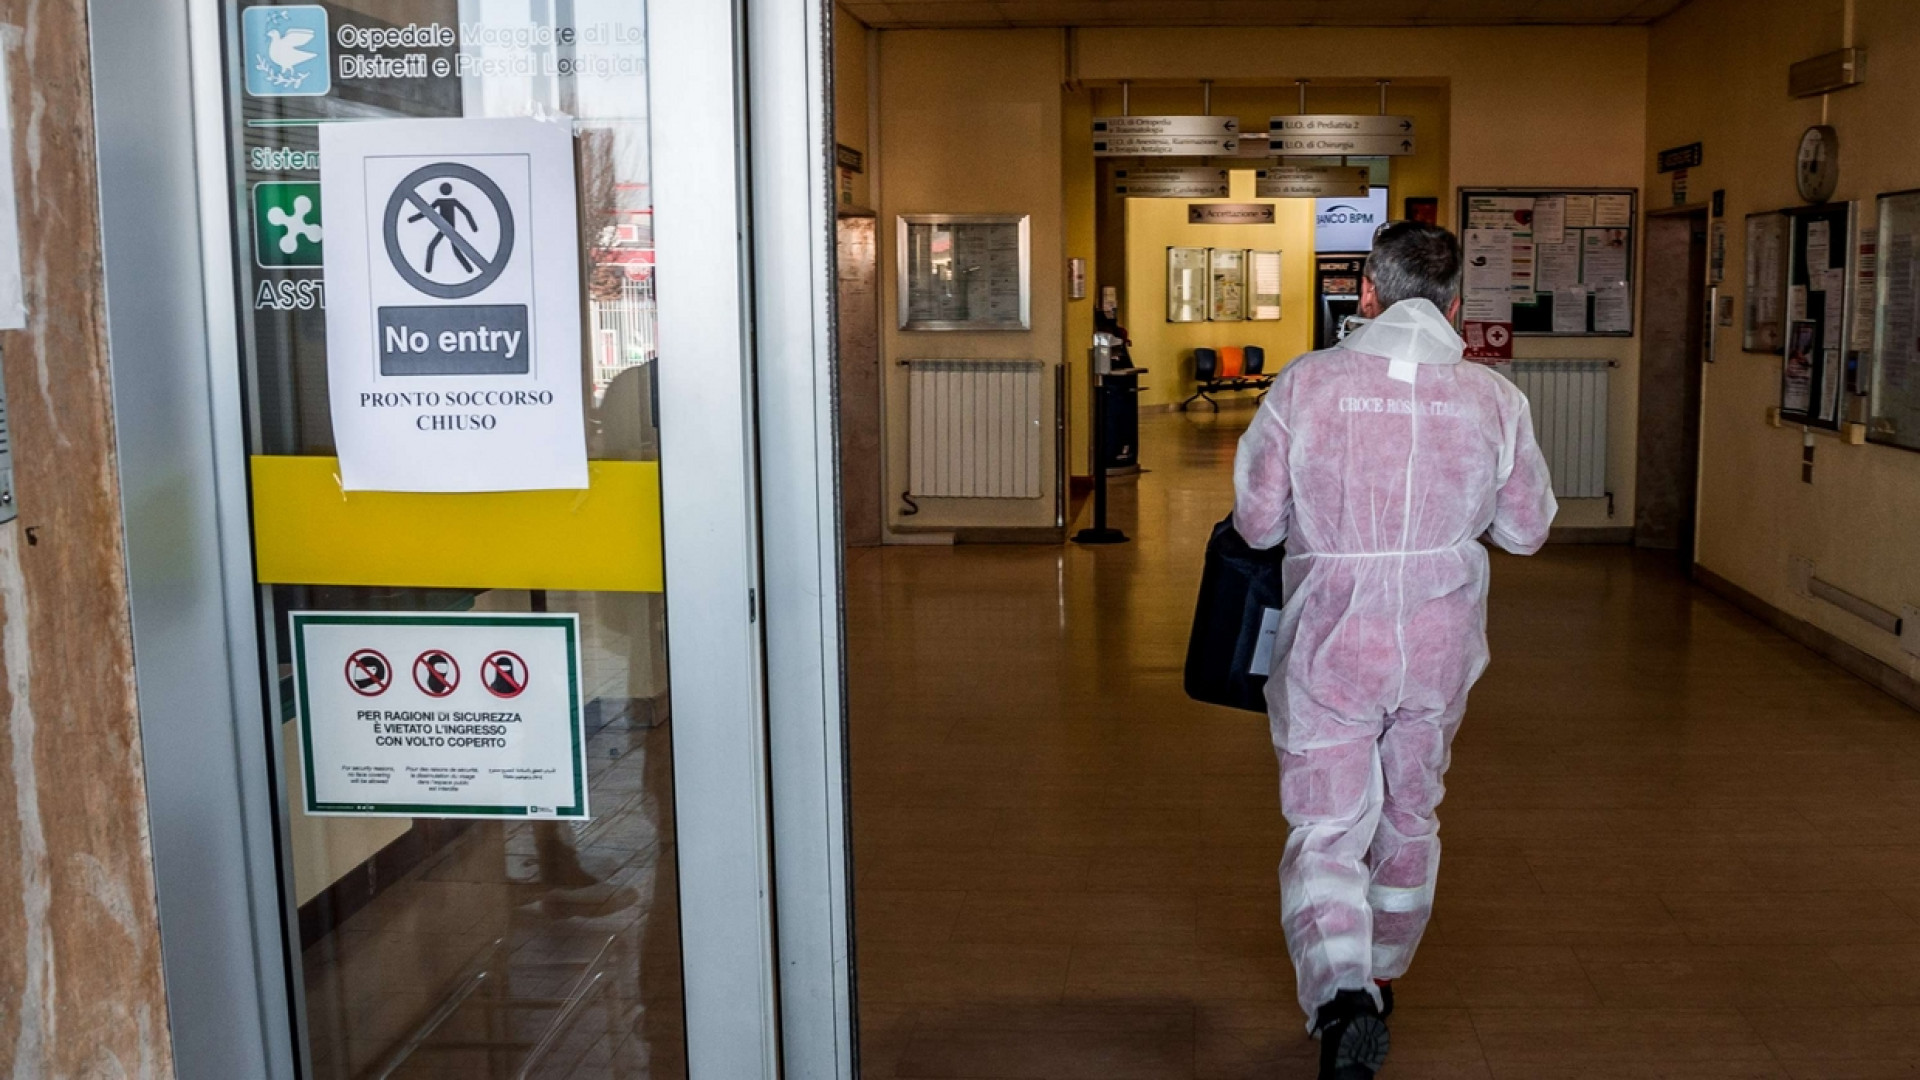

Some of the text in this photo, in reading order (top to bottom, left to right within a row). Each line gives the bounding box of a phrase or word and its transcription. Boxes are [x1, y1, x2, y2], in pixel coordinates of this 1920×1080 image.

[338, 23, 455, 50] Ospedale
[461, 23, 576, 49] Maggiore
[615, 22, 646, 45] Lo
[340, 54, 427, 77] Distretti
[432, 56, 450, 76] e
[456, 53, 539, 77] Presidi
[1307, 120, 1314, 129] di
[1317, 120, 1353, 129] Pediatria
[1307, 140, 1314, 149] di
[1317, 140, 1354, 151] Chirurgia
[1349, 213, 1374, 224] BPM
[385, 325, 522, 359] No entry
[360, 390, 554, 407] PRONTO SOCCORSO
[1386, 398, 1428, 415] ROSA
[416, 413, 496, 430] CHIUSO
[357, 710, 522, 723] PER RAGIONI DI SICUREZZA
[374, 720, 507, 736] È VIETATO L'INGRESSO
[376, 735, 507, 748] CON VOLTO COPERTO
